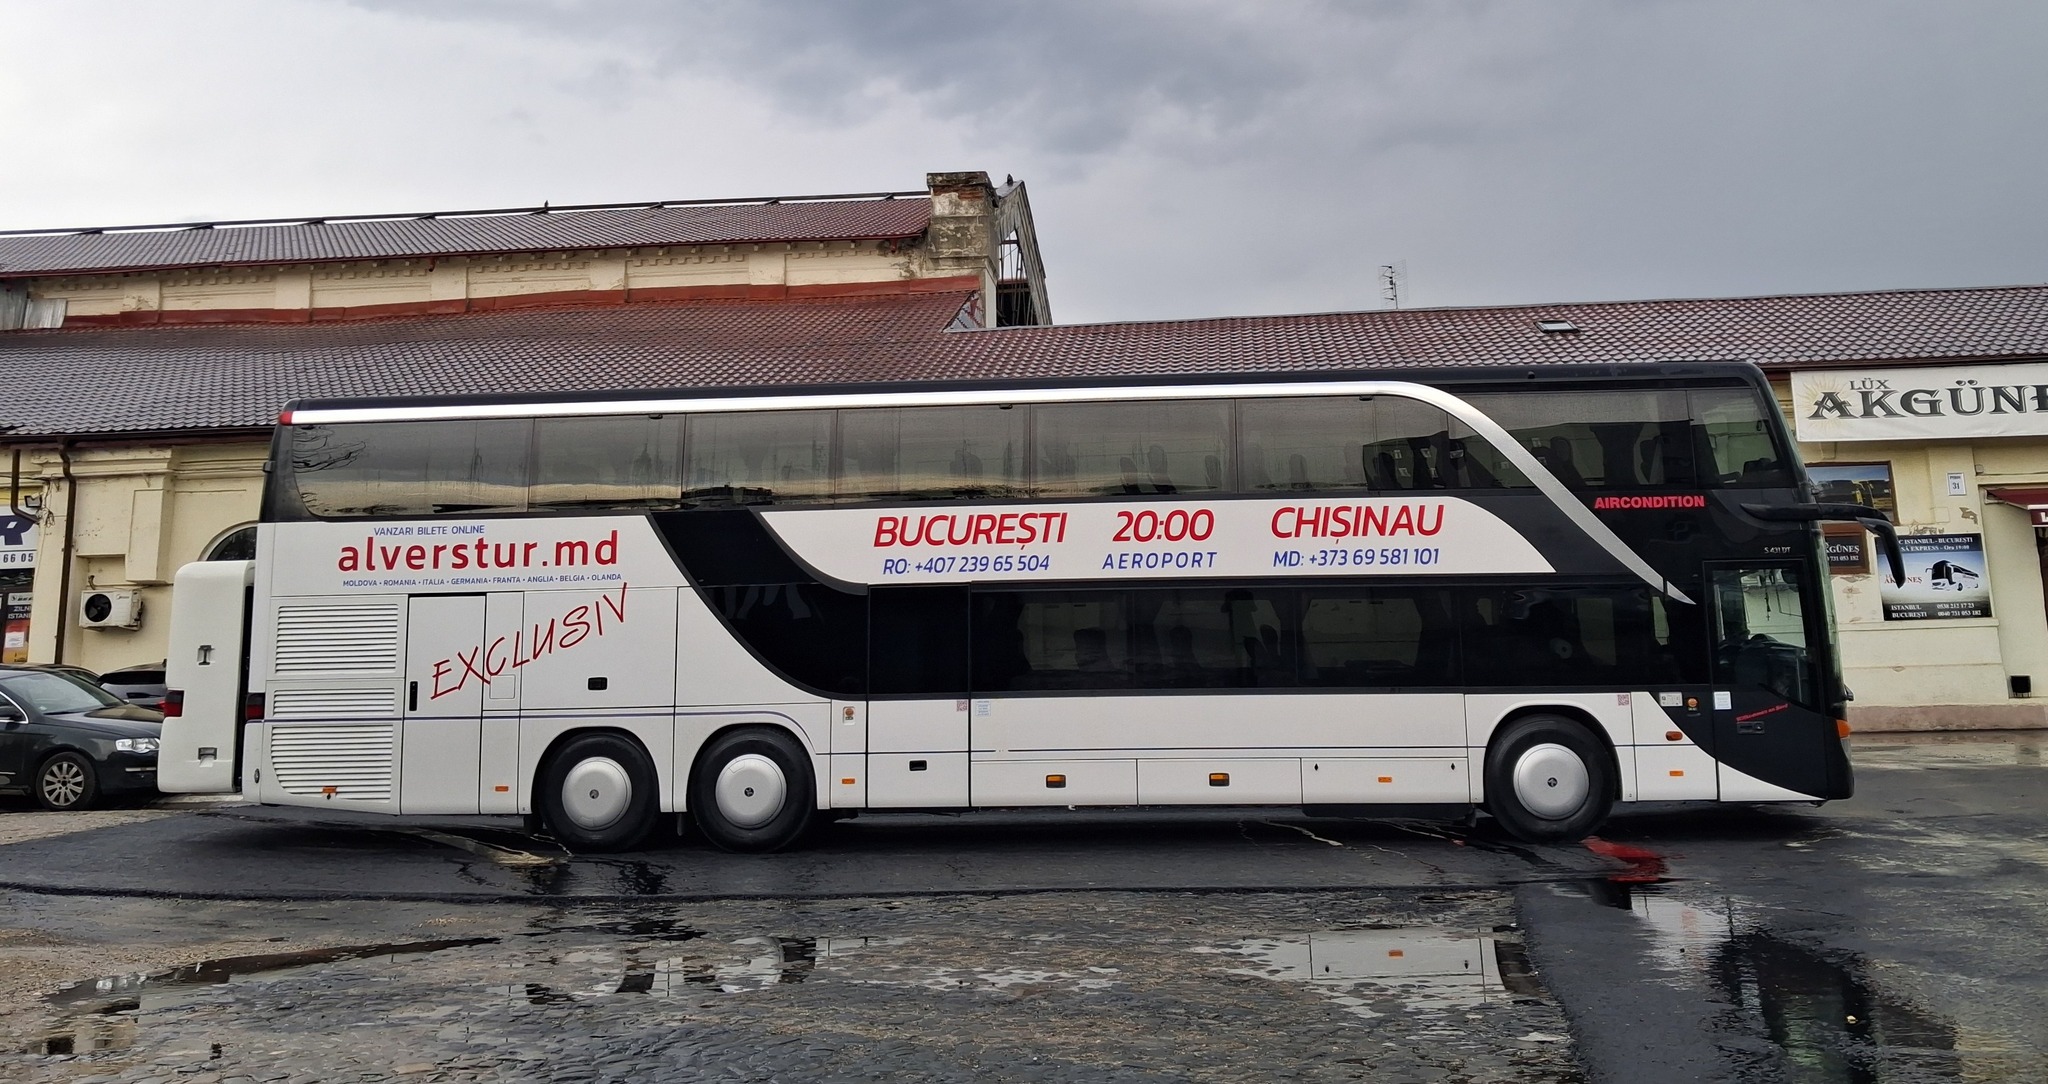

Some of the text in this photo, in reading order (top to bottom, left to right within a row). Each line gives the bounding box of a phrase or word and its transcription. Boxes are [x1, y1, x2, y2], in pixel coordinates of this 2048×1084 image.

[1850, 377, 1891, 391] LÜX
[1952, 482, 1960, 490] 31
[1594, 495, 1705, 509] AIRCONDITION
[373, 524, 485, 536] VANZARI BILETE ONLINE
[873, 512, 1068, 550] BUCUREȘTI
[1112, 508, 1215, 543] 20:00
[1271, 504, 1445, 544] CHIȘINAU
[3, 552, 34, 563] 66 05
[338, 530, 618, 571] alverstur.md
[1273, 548, 1439, 567] MD: +373 69 581 101
[883, 554, 1050, 575] RO: +407 239 65 504
[1102, 551, 1217, 569] AEROPORT
[342, 573, 622, 587] MOLDOVA ROMANIA ITALIA GERMANIA FRANTA ANGLIA BELGIA OLANDA
[430, 582, 627, 700] EXCLUSIV
